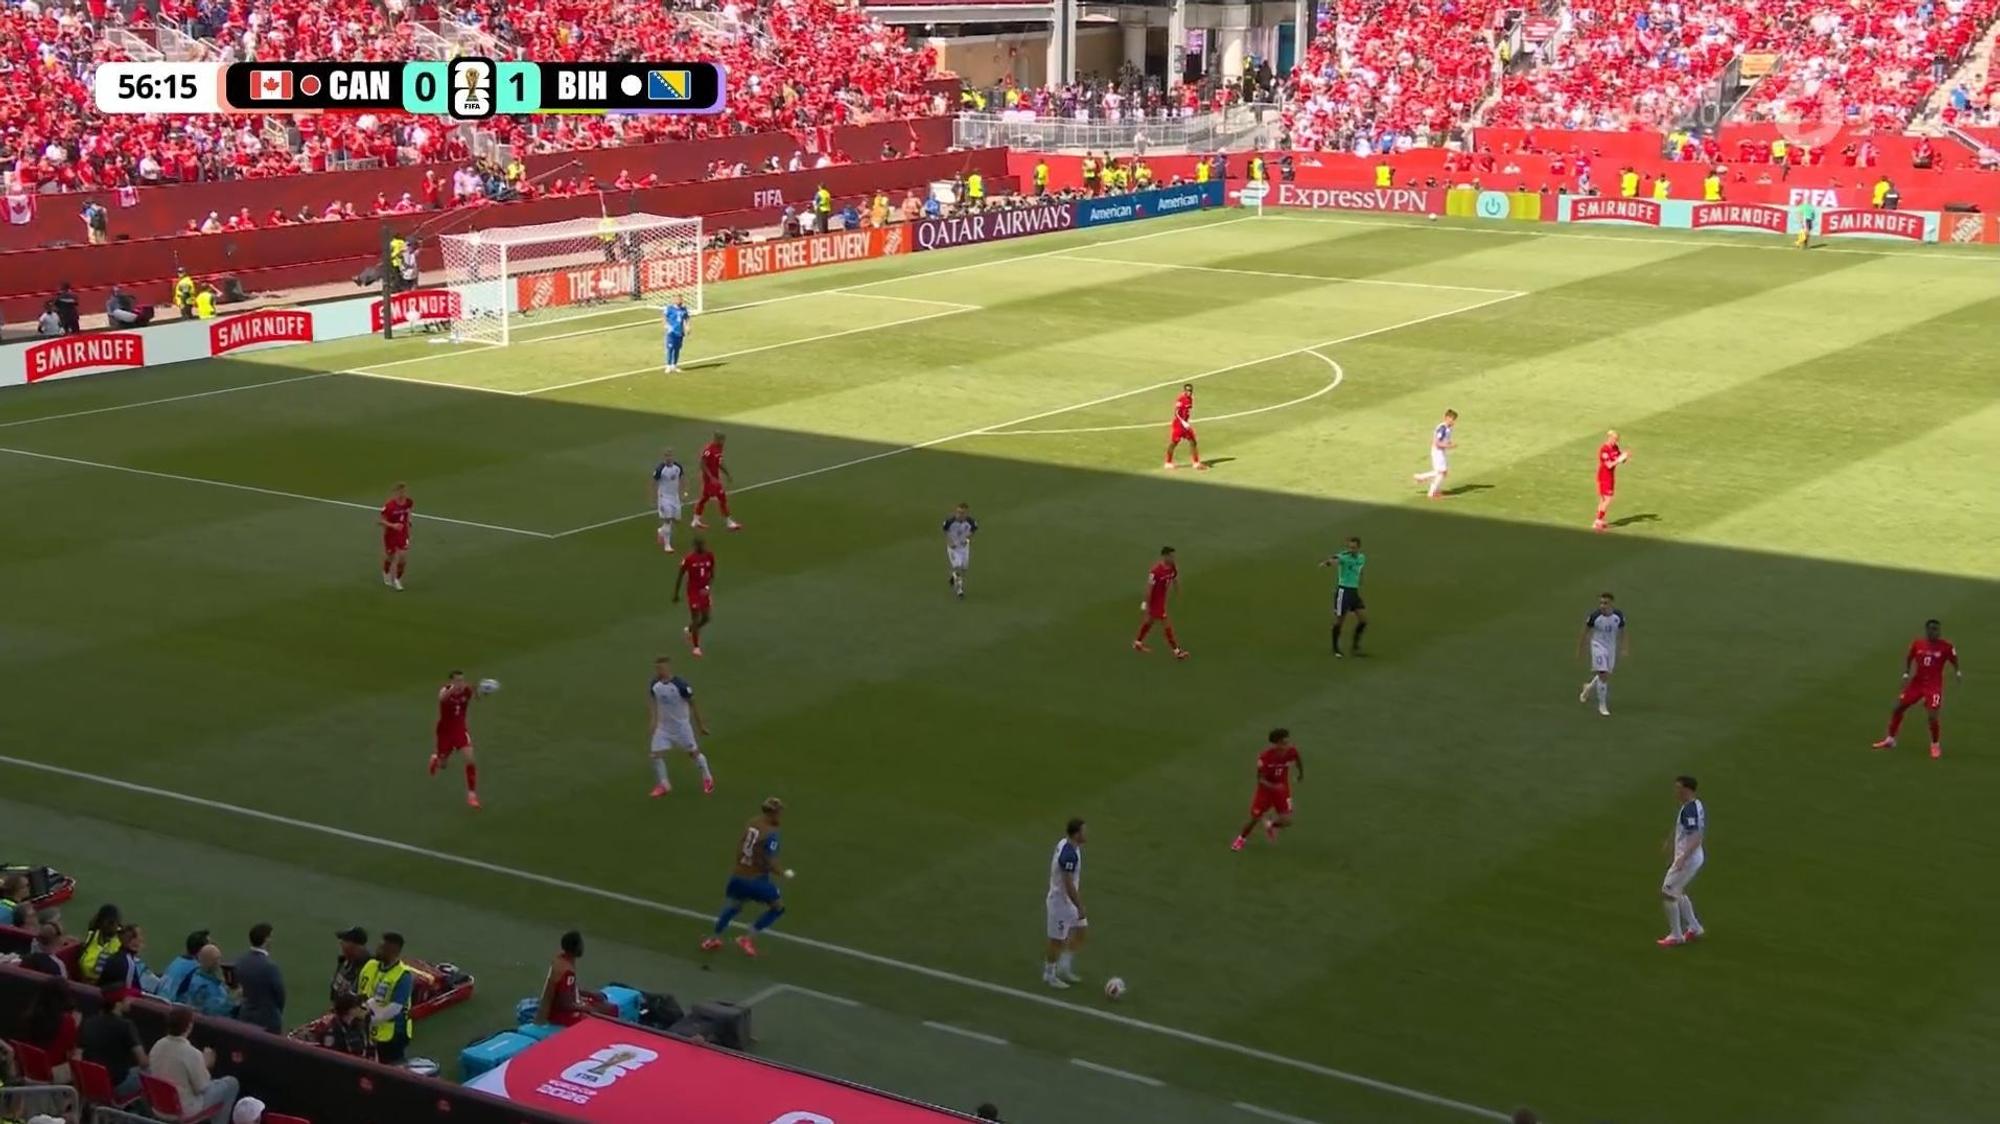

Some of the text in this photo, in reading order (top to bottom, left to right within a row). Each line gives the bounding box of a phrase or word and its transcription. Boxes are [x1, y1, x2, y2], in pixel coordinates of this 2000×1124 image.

[753, 189, 785, 208] FIFA
[1157, 194, 1200, 212] American
[1278, 184, 1429, 213] ExpressVPN
[1789, 188, 1839, 208] FIFA
[1089, 203, 1133, 222] American
[1577, 200, 1655, 220] SMIRNOFF
[1699, 204, 1782, 226] SMIRNOFF
[917, 216, 985, 250] QATAR
[993, 203, 1072, 236] AIRWAYS
[1828, 213, 1917, 235] SMIRNOFF
[738, 245, 772, 275] FAST
[775, 240, 808, 269] FREE
[810, 231, 872, 264] DELIVERY
[568, 268, 596, 300] THE
[600, 264, 635, 295] HOM
[650, 255, 695, 289] DEPOT
[217, 315, 306, 348] SMIRNOFF
[35, 338, 136, 373] SMIRNOFF
